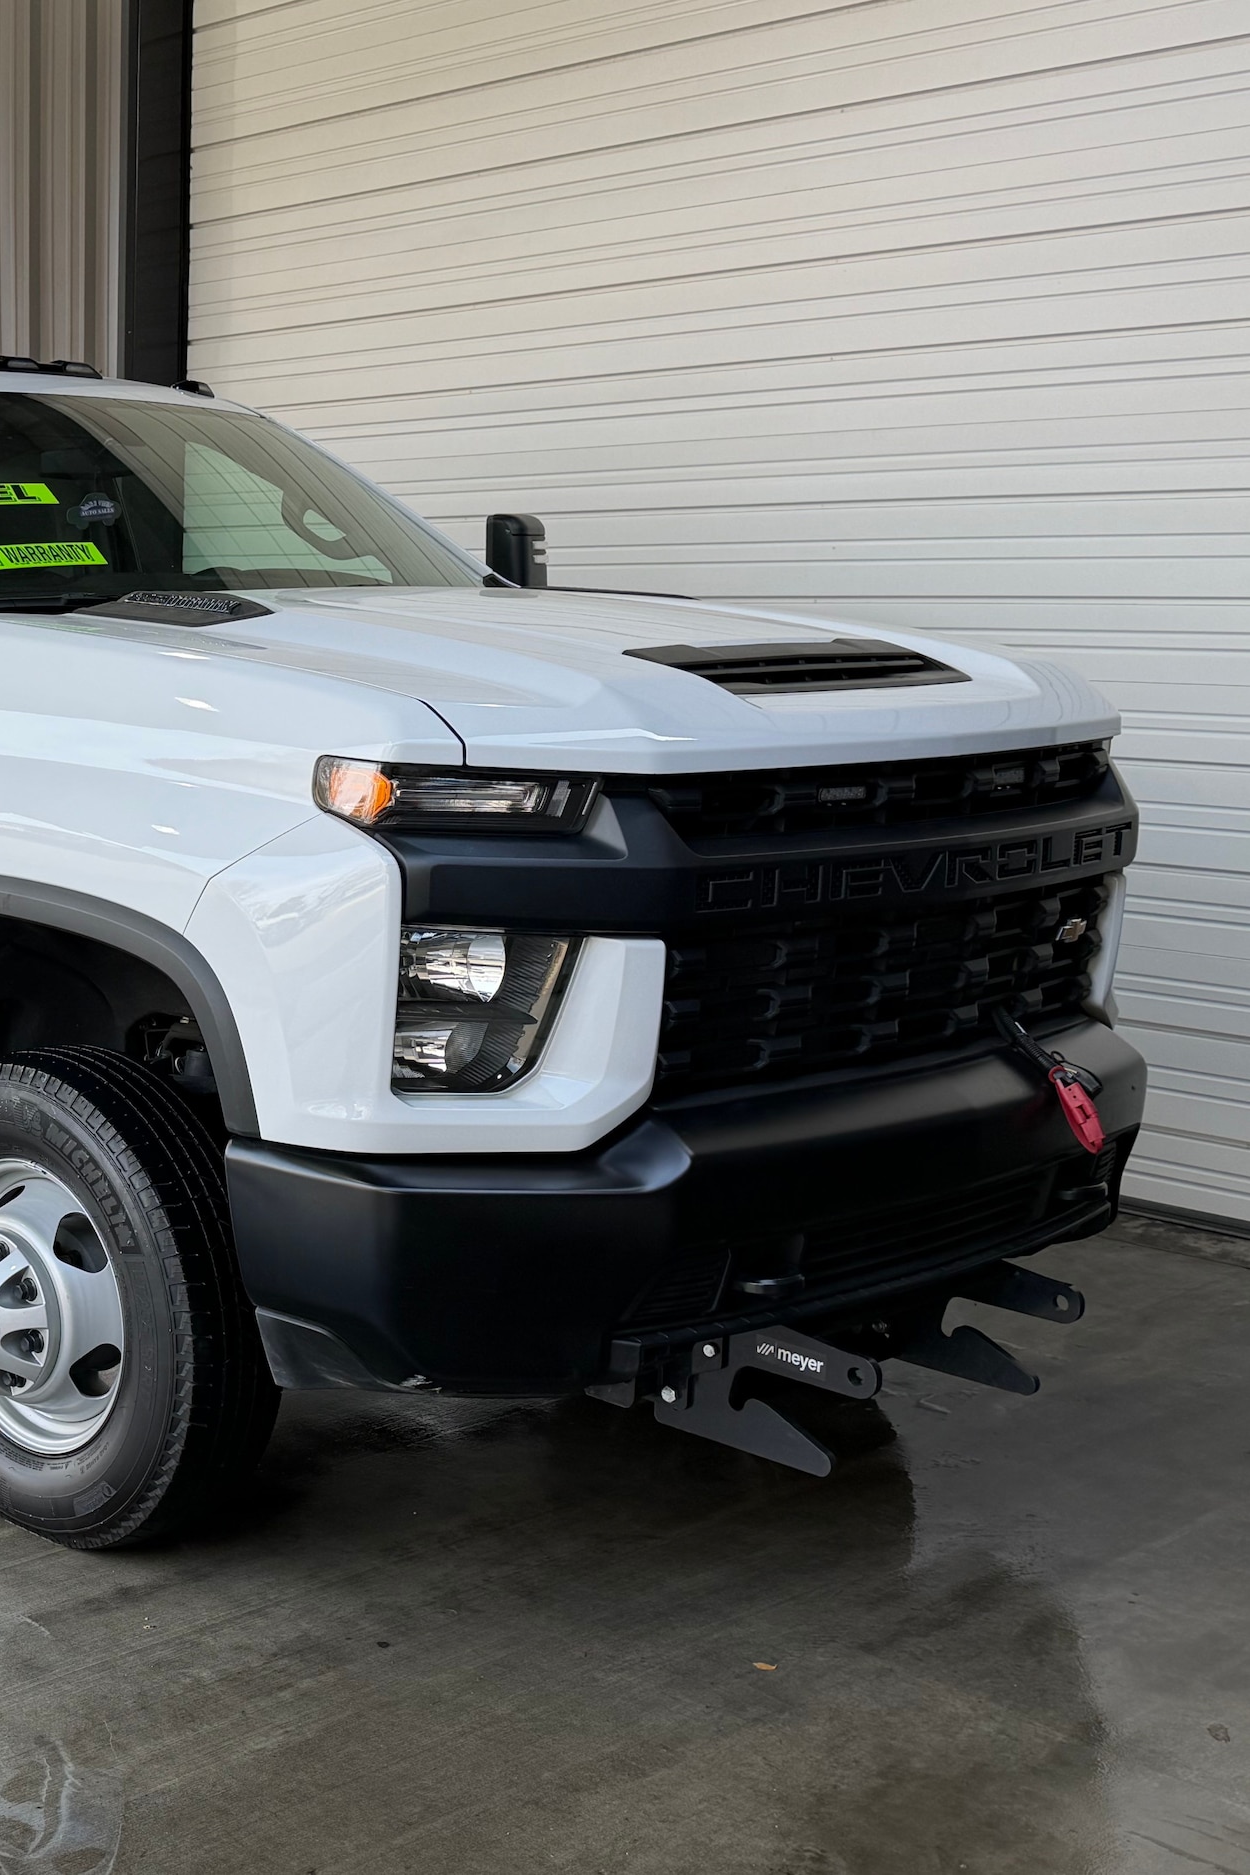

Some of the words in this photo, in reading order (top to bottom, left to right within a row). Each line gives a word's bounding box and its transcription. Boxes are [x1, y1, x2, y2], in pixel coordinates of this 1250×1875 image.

[1, 543, 92, 564] WARRANTY
[696, 822, 1132, 912] CHEVROLET
[46, 1122, 136, 1248] MICHELIN
[777, 1348, 824, 1373] meyer
